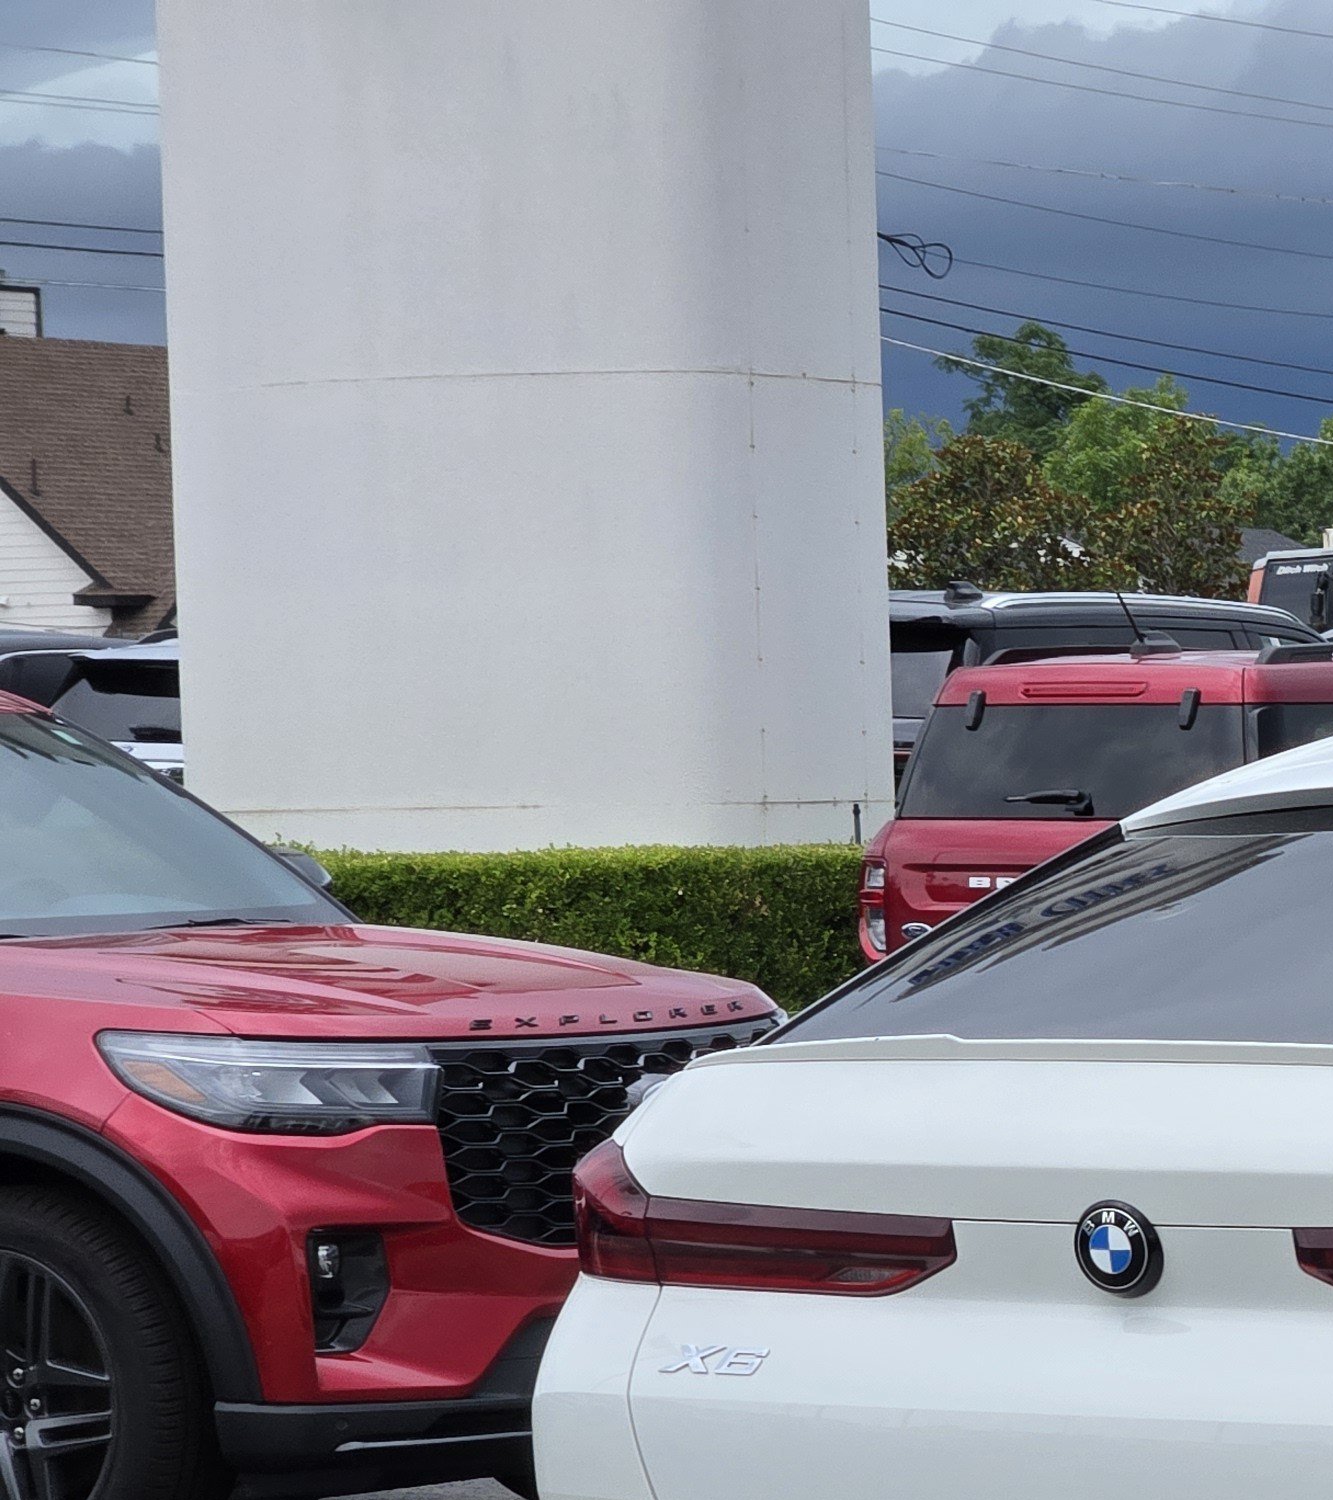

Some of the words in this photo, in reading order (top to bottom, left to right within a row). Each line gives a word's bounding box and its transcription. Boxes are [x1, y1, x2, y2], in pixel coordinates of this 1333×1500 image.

[468, 1000, 745, 1031] EXPLORER
[1082, 1211, 1139, 1237] BMW
[658, 1344, 771, 1376] X6
